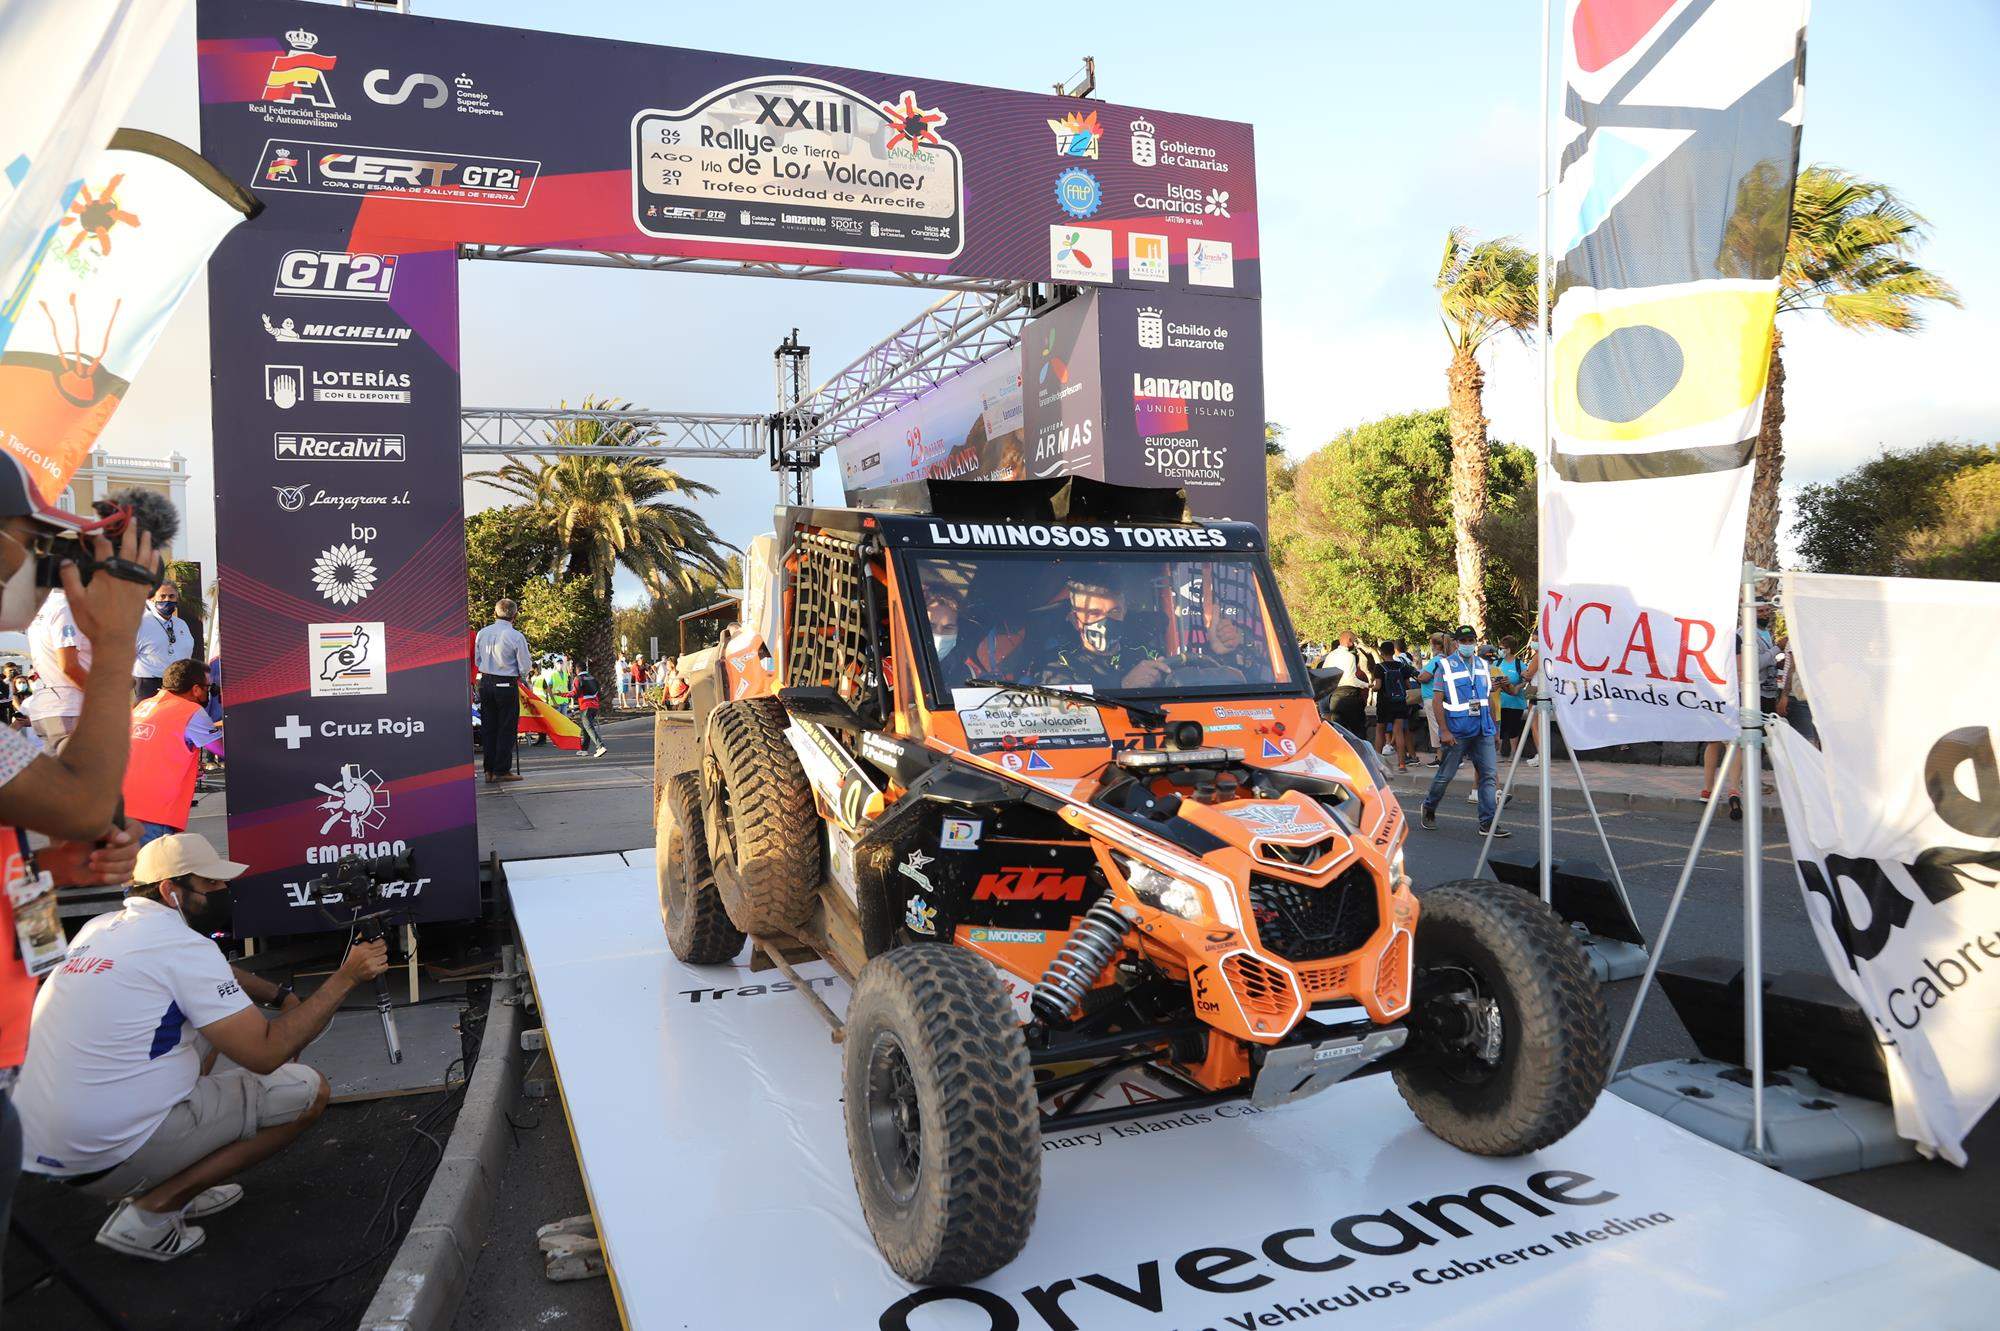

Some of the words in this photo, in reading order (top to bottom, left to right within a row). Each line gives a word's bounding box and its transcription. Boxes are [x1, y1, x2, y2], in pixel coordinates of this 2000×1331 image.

[456, 90, 488, 100] Consejo
[457, 97, 490, 107] Superior
[248, 103, 267, 113] Real
[269, 105, 314, 118] Federación
[315, 109, 352, 121] Española
[469, 106, 504, 116] Deportes
[754, 93, 852, 134] XXIII
[263, 114, 275, 123] de
[276, 115, 338, 128] Automovilismo
[660, 128, 680, 138] 06
[660, 136, 681, 145] 07
[700, 124, 776, 156] Rallye
[781, 143, 798, 155] de
[803, 145, 840, 160] Tierra
[1159, 140, 1216, 158] Gobierno
[650, 152, 693, 163] AGO
[1160, 153, 1175, 166] de
[1177, 154, 1229, 173] Canarias
[319, 153, 458, 187] CERT
[661, 169, 682, 178] 20
[701, 159, 722, 174] Isla
[728, 154, 761, 176] de
[773, 156, 811, 181] Los
[823, 160, 925, 191] Volcanes
[662, 176, 681, 186] 21
[322, 180, 350, 188] COPA
[352, 182, 365, 190] DE
[367, 183, 406, 193] ESPAÑA
[423, 188, 465, 197] RALLYES
[468, 191, 480, 199] DE
[482, 192, 516, 201] TIERRA
[702, 179, 758, 194] Trofeo
[763, 184, 828, 201] Ciudad
[833, 190, 856, 204] de
[861, 193, 926, 210] Arrecife
[1167, 183, 1203, 200] Islas
[663, 206, 706, 218] CERT
[1133, 193, 1203, 215] Canarias
[781, 212, 827, 227] Lanzarote
[831, 219, 863, 232] sports
[911, 228, 940, 238] Canarias
[275, 250, 397, 299] GT2i
[302, 324, 412, 340] MICHELIN
[1166, 322, 1210, 337] Cabildo
[1213, 326, 1228, 338] de
[1167, 336, 1225, 351] Lanzarote
[312, 369, 411, 388] LOTERÍAS
[1133, 372, 1234, 402] Lanzarote
[359, 392, 400, 400] DEPORTE
[1134, 404, 1141, 412] A
[1147, 404, 1189, 415] UNIQUE
[1195, 407, 1235, 417] ISLAND
[299, 437, 382, 458] Recalvi
[1034, 419, 1092, 462] ARMAS
[1145, 436, 1199, 449] european
[1164, 468, 1220, 479] DESTINATION
[309, 489, 388, 510] Lanzagrava
[391, 490, 411, 505] s.l.
[351, 522, 377, 544] bp
[929, 523, 1111, 547] LUMINOSOS
[1121, 527, 1228, 548] TORRES
[1005, 694, 1049, 708] XXIII
[1581, 677, 1669, 707] Islands
[1676, 690, 1727, 715] Car
[985, 710, 1019, 720] Rallye
[1000, 719, 1015, 728] de
[1018, 719, 1037, 728] Los
[1042, 717, 1087, 726] Volcanes
[320, 720, 372, 737] Cruz
[377, 717, 425, 738] Roja
[971, 866, 1087, 901] KTM
[987, 929, 1043, 943] MOTOREX
[1110, 1112, 1212, 1139] Islands
[878, 1168, 1619, 1331] Orvecame
[1223, 1278, 1411, 1331] Vehículos
[1412, 1241, 1553, 1286] Cabrera
[1552, 1209, 1675, 1253] Medina
